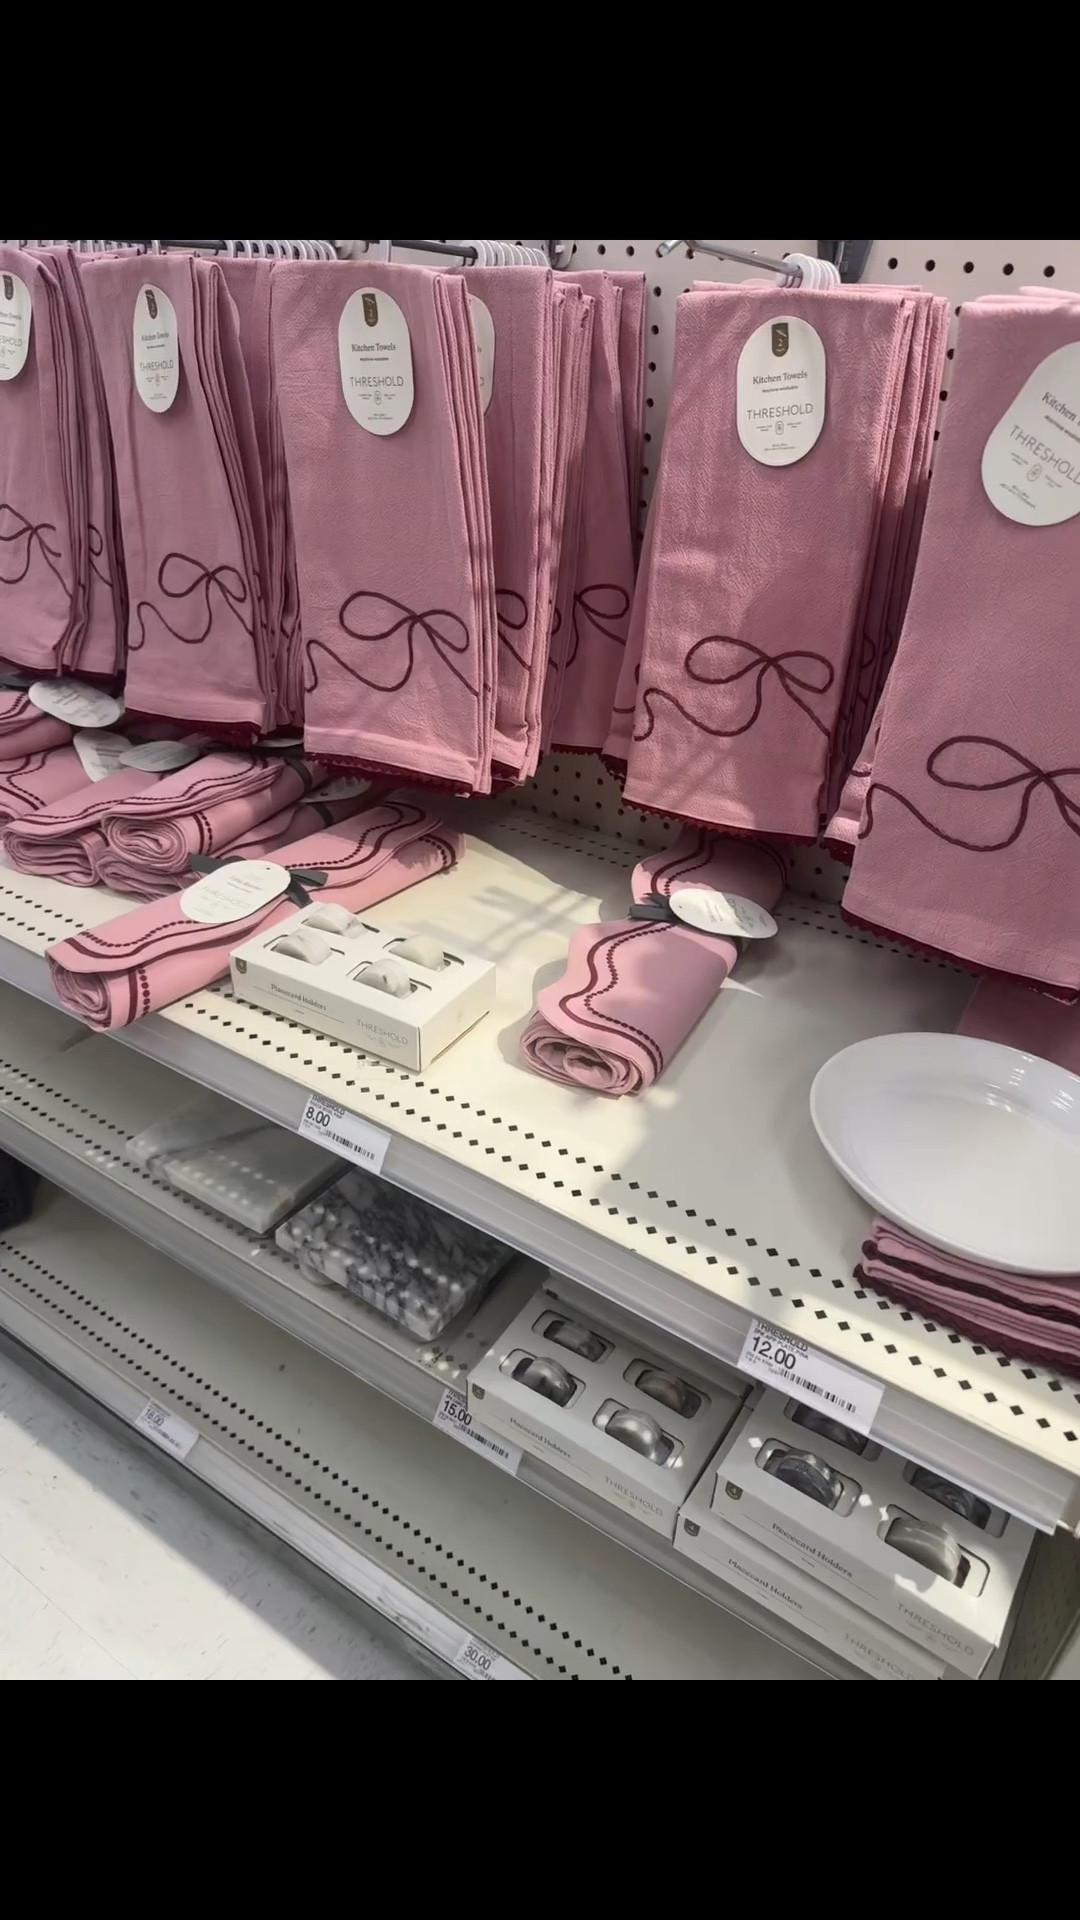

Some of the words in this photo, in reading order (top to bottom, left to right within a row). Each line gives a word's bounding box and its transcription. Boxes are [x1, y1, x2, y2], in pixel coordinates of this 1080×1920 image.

[351, 343, 375, 352] Kitchen
[376, 342, 396, 351] Towels
[139, 359, 174, 371] THRESHOLD
[752, 374, 782, 385] Kitchen
[783, 370, 808, 381] Towels
[349, 376, 404, 387] THRESHOLD
[746, 402, 814, 420] THRESHOLD
[1042, 392, 1077, 422] Kitchen
[357, 1019, 408, 1045] THRESHOLD
[306, 1106, 331, 1127] 8.00
[757, 1320, 809, 1352] THRESHOLD
[753, 1336, 797, 1370] 12.00
[444, 1400, 472, 1425] 15.00
[604, 1476, 663, 1516] THRESHOLD
[817, 1550, 853, 1578] Holders
[728, 1558, 769, 1588] Placecard
[769, 1585, 803, 1610] Holders
[898, 1604, 975, 1657] THRESHOLD
[464, 1645, 492, 1671] 30.00
